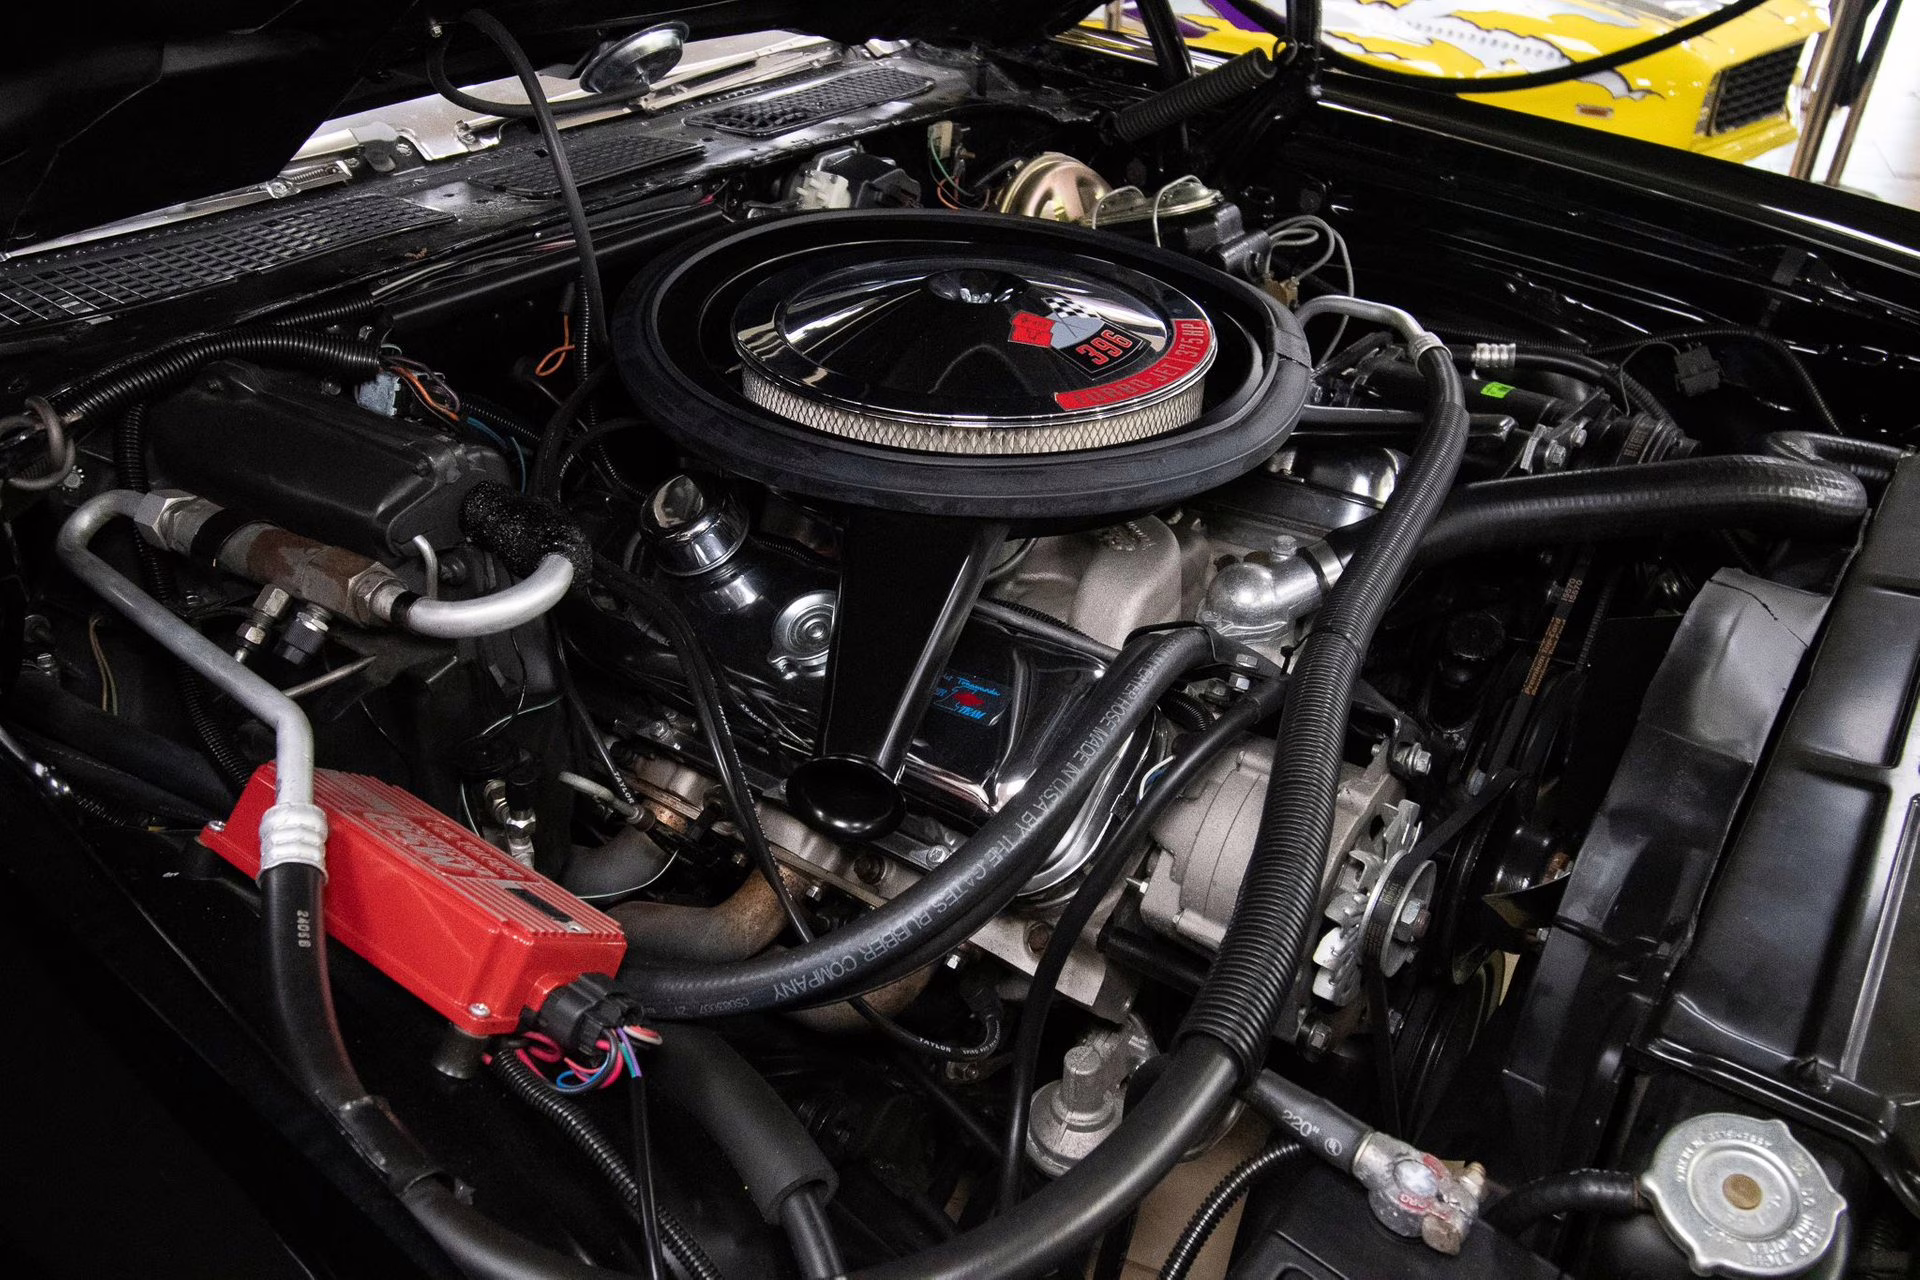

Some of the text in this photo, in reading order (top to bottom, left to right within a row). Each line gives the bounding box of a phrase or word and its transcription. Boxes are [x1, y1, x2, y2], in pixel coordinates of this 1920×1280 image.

[1076, 329, 1133, 365] 396
[1099, 697, 1130, 728] HOSE
[1071, 725, 1108, 766] MADE
[613, 771, 635, 804] TAYLOR
[1060, 760, 1081, 782] IN
[1015, 811, 1041, 838] BY
[987, 834, 1019, 867] THE
[935, 862, 987, 914] GATES
[860, 914, 932, 962] RUBBER
[774, 956, 857, 1001] COMPANY
[920, 1037, 951, 1053] TAYLOR
[1281, 1110, 1320, 1137] 220"
